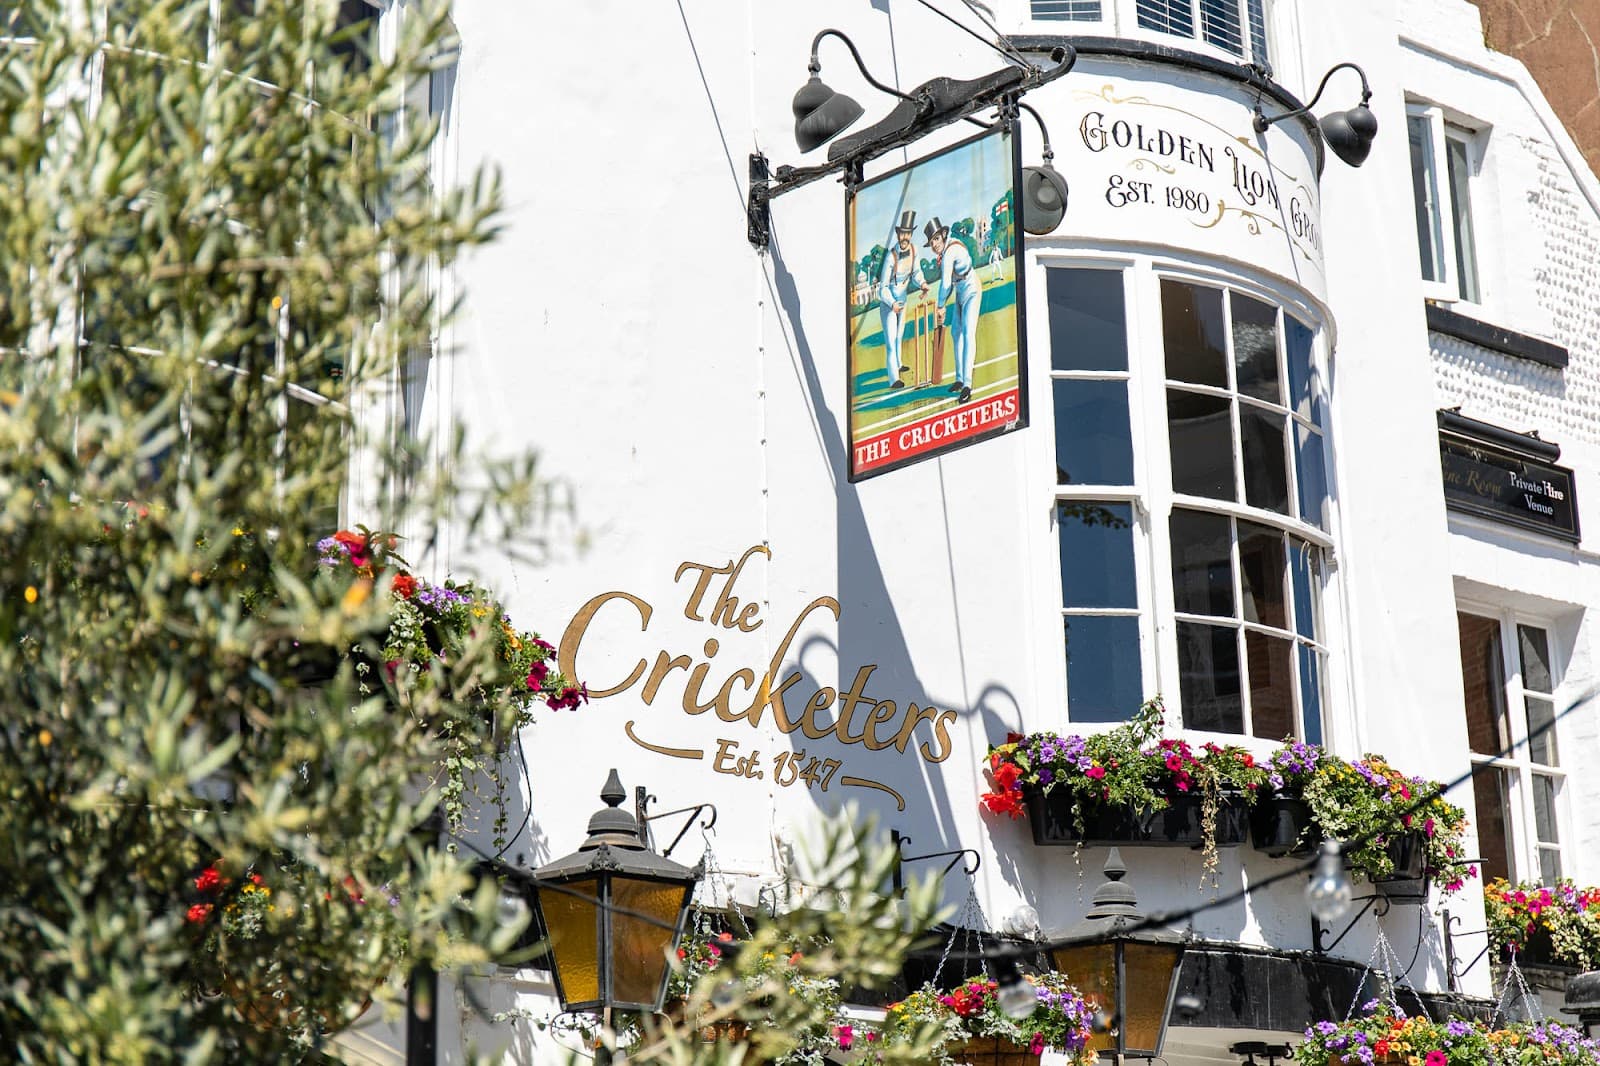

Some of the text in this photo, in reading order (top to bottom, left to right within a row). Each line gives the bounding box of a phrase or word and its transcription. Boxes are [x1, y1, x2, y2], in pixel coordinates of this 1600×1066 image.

[1166, 186, 1210, 214] 1980
[855, 395, 1016, 466] THE CRICKETERS
[1509, 471, 1564, 501] Private Hire
[1524, 494, 1554, 515] Venue
[674, 544, 772, 633] The
[558, 591, 958, 764] Cricketers
[712, 738, 843, 792] Est. 1547
